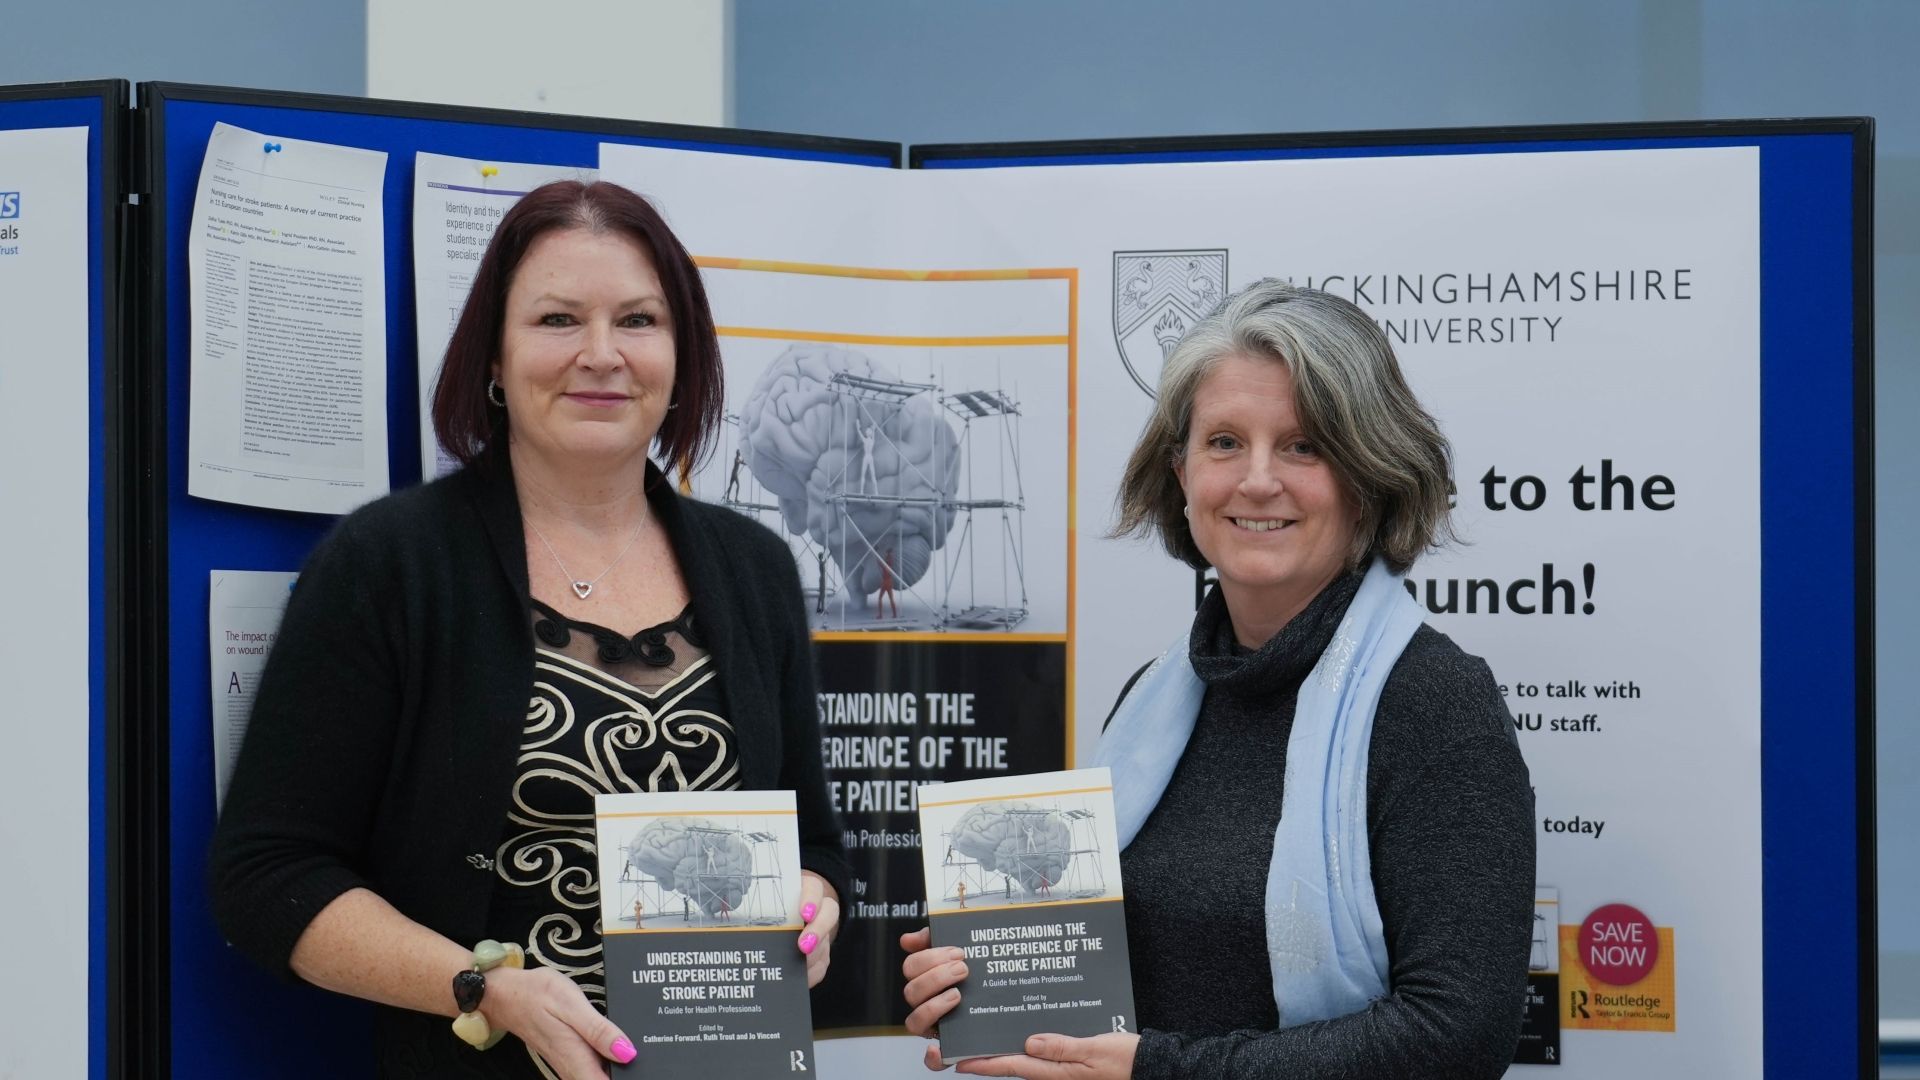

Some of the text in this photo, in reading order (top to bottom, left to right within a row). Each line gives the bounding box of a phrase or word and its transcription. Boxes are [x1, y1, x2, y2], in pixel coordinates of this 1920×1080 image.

[211, 188, 226, 199] Nursing
[245, 197, 260, 206] stroke
[260, 200, 282, 210] patients:
[290, 206, 309, 215] survey
[318, 211, 338, 219] current
[339, 214, 362, 222] practice
[445, 201, 472, 217] Identity
[473, 205, 487, 217] and
[488, 205, 500, 217] the
[446, 219, 484, 232] experience
[485, 221, 494, 232] of
[446, 234, 476, 246] students
[0, 246, 18, 255] rust
[447, 248, 480, 261] specialist
[1289, 268, 1692, 305] CKINGHAMSHIRE
[1376, 316, 1562, 344] NIVERSITY
[1480, 464, 1546, 511] to
[1568, 459, 1676, 511] the
[1404, 562, 1596, 615] unch!
[225, 630, 239, 642] The
[241, 631, 267, 643] impact
[226, 646, 236, 655] on
[238, 644, 264, 655] wound
[228, 671, 242, 694] A
[1516, 682, 1539, 698] to
[1546, 680, 1586, 698] talk
[1594, 680, 1641, 699] with
[816, 692, 975, 725] STANDING THE
[1512, 713, 1602, 732] NU staff.
[822, 736, 1008, 769] ERIENCE OF THE
[847, 780, 944, 812] PATIE
[1543, 816, 1605, 838] today
[861, 829, 922, 848] Professio
[856, 878, 867, 895] by
[857, 901, 888, 917] Trout
[892, 900, 918, 917] and
[971, 922, 1087, 942] UNDERSTANDING THE
[1592, 922, 1643, 942] SAVE
[964, 938, 1103, 959] IVED EXPERIENCE OF THE
[1591, 946, 1646, 967] NOW
[647, 950, 766, 967] UNDERSTANDING THE
[987, 956, 1076, 974] STROKE PATIENT
[632, 967, 782, 984] LIVED EXPERIENCE OF THE
[983, 974, 1084, 987] A Guide for Health Professionals
[662, 985, 755, 1000] STROKE PATIENT
[1023, 994, 1047, 1002] Edited by
[1532, 995, 1544, 1004] THE
[664, 1006, 683, 1015] Guide
[685, 1006, 694, 1014] for
[695, 1005, 717, 1014] Health
[718, 1004, 762, 1014] Professionals
[969, 999, 1102, 1014] Catherine Forward, Ruth Trout and Jo Vincent
[1594, 993, 1660, 1010] Routledge
[1649, 1011, 1670, 1020] Group
[699, 1024, 724, 1032] Edited by
[643, 1035, 673, 1043] Catherine
[675, 1034, 702, 1043] Forward,
[703, 1033, 718, 1041] Ruth
[719, 1033, 735, 1041] Trout
[757, 1032, 780, 1040] Vincent
